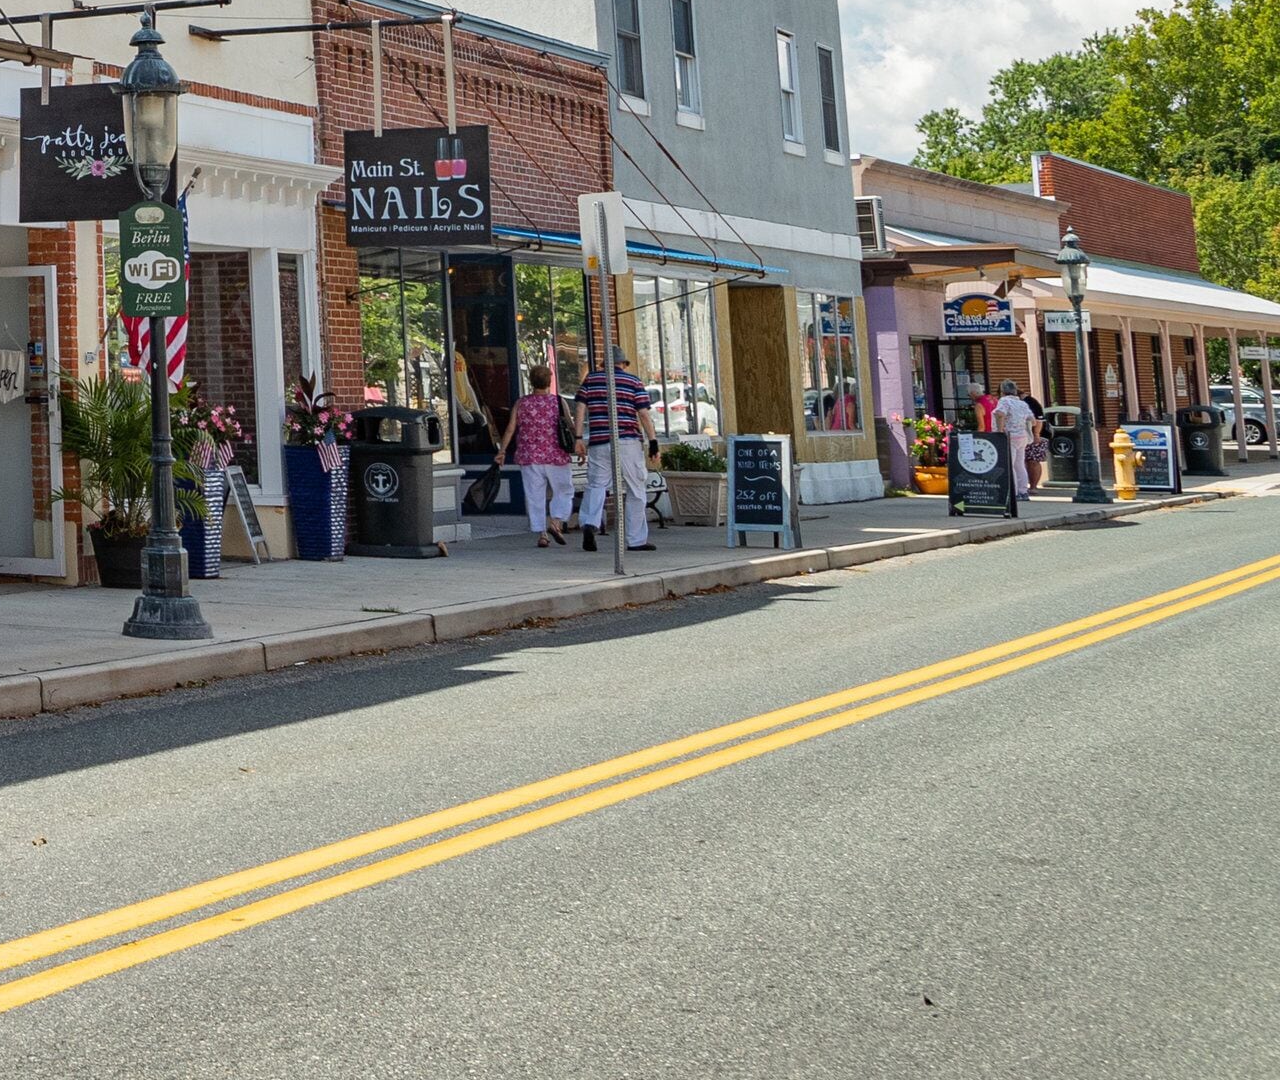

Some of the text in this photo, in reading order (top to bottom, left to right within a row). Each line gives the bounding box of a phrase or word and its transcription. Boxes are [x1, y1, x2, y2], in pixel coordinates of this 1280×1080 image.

[23, 125, 127, 154] patty jea
[61, 148, 123, 157] BOUTIQU
[351, 158, 424, 182] Main St.
[351, 184, 484, 220] NAILS
[351, 223, 485, 233] Manicure Pedicure Acrylic Nails
[132, 231, 170, 244] Berlin
[136, 292, 172, 304] FREE
[946, 317, 1000, 328] Creamery
[770, 449, 777, 457] A
